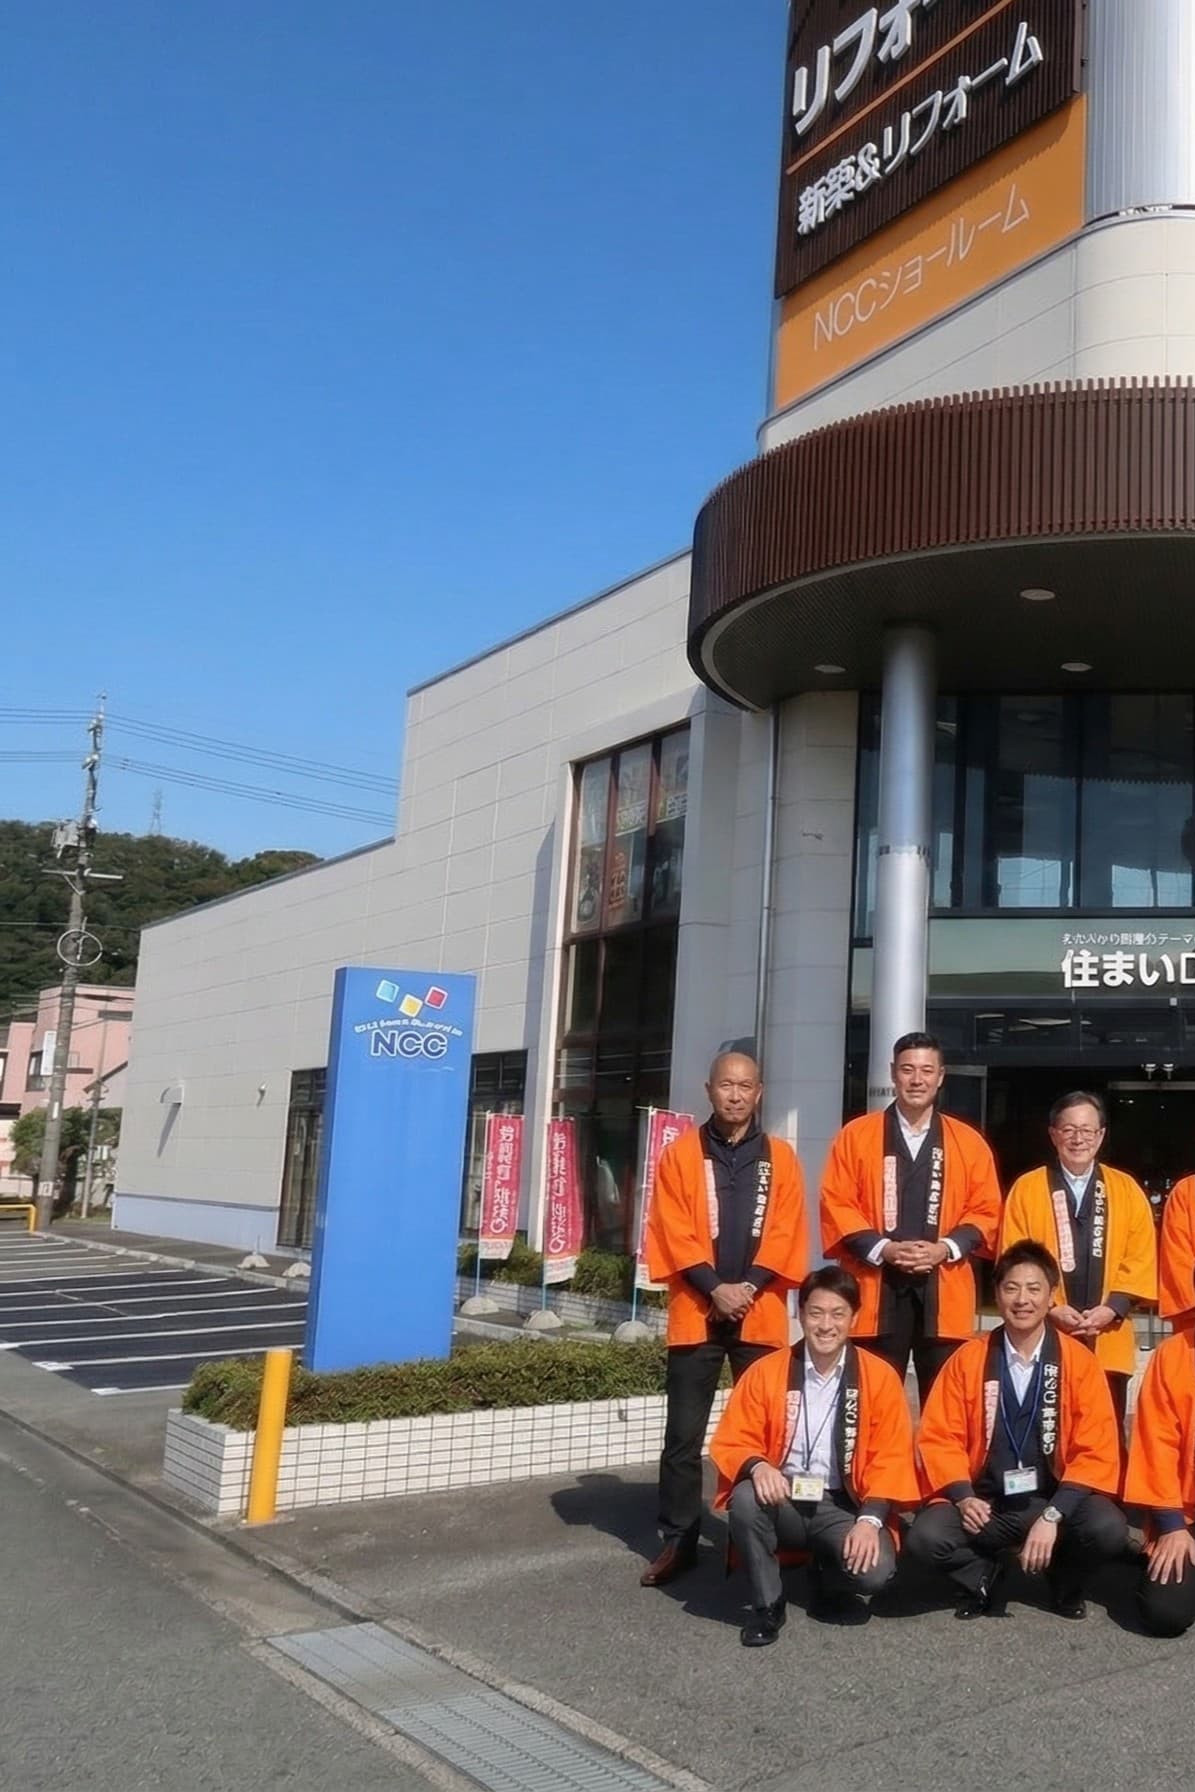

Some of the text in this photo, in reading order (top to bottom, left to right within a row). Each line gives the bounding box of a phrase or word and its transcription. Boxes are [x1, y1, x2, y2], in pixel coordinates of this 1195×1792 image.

[792, 0, 938, 135] リフォ
[370, 1029, 448, 1060] NCC
